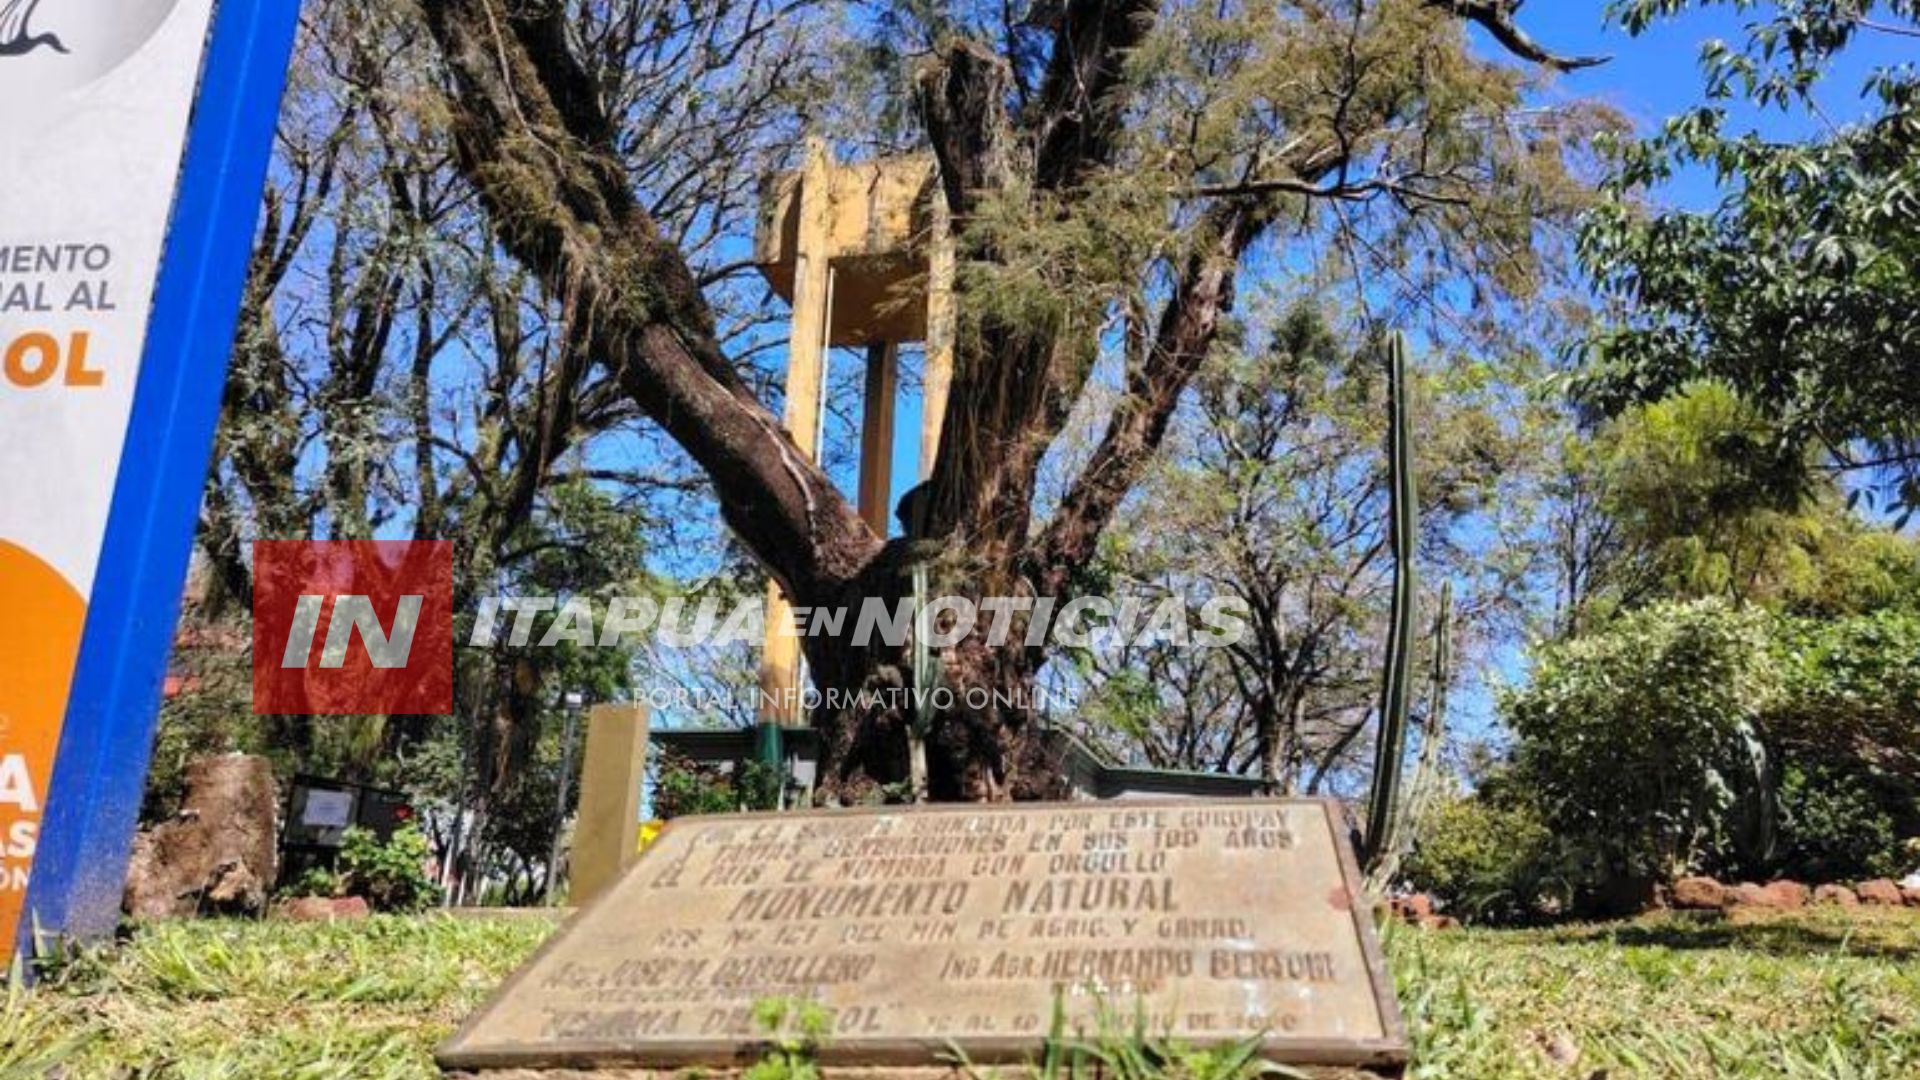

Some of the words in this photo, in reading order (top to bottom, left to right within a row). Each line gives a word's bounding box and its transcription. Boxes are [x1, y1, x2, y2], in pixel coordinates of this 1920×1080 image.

[0, 280, 52, 311] AL
[65, 280, 116, 311] AL
[1028, 832, 1063, 852] EN
[835, 857, 947, 881] NOMBRA
[971, 854, 1025, 876] CON
[1049, 851, 1167, 875] ORGULLO
[728, 882, 970, 922] MONUMENTO
[1001, 876, 1181, 914] NATURAL
[978, 917, 1012, 940] DE
[1120, 917, 1139, 936] Y
[1042, 947, 1194, 980] HERNANDO
